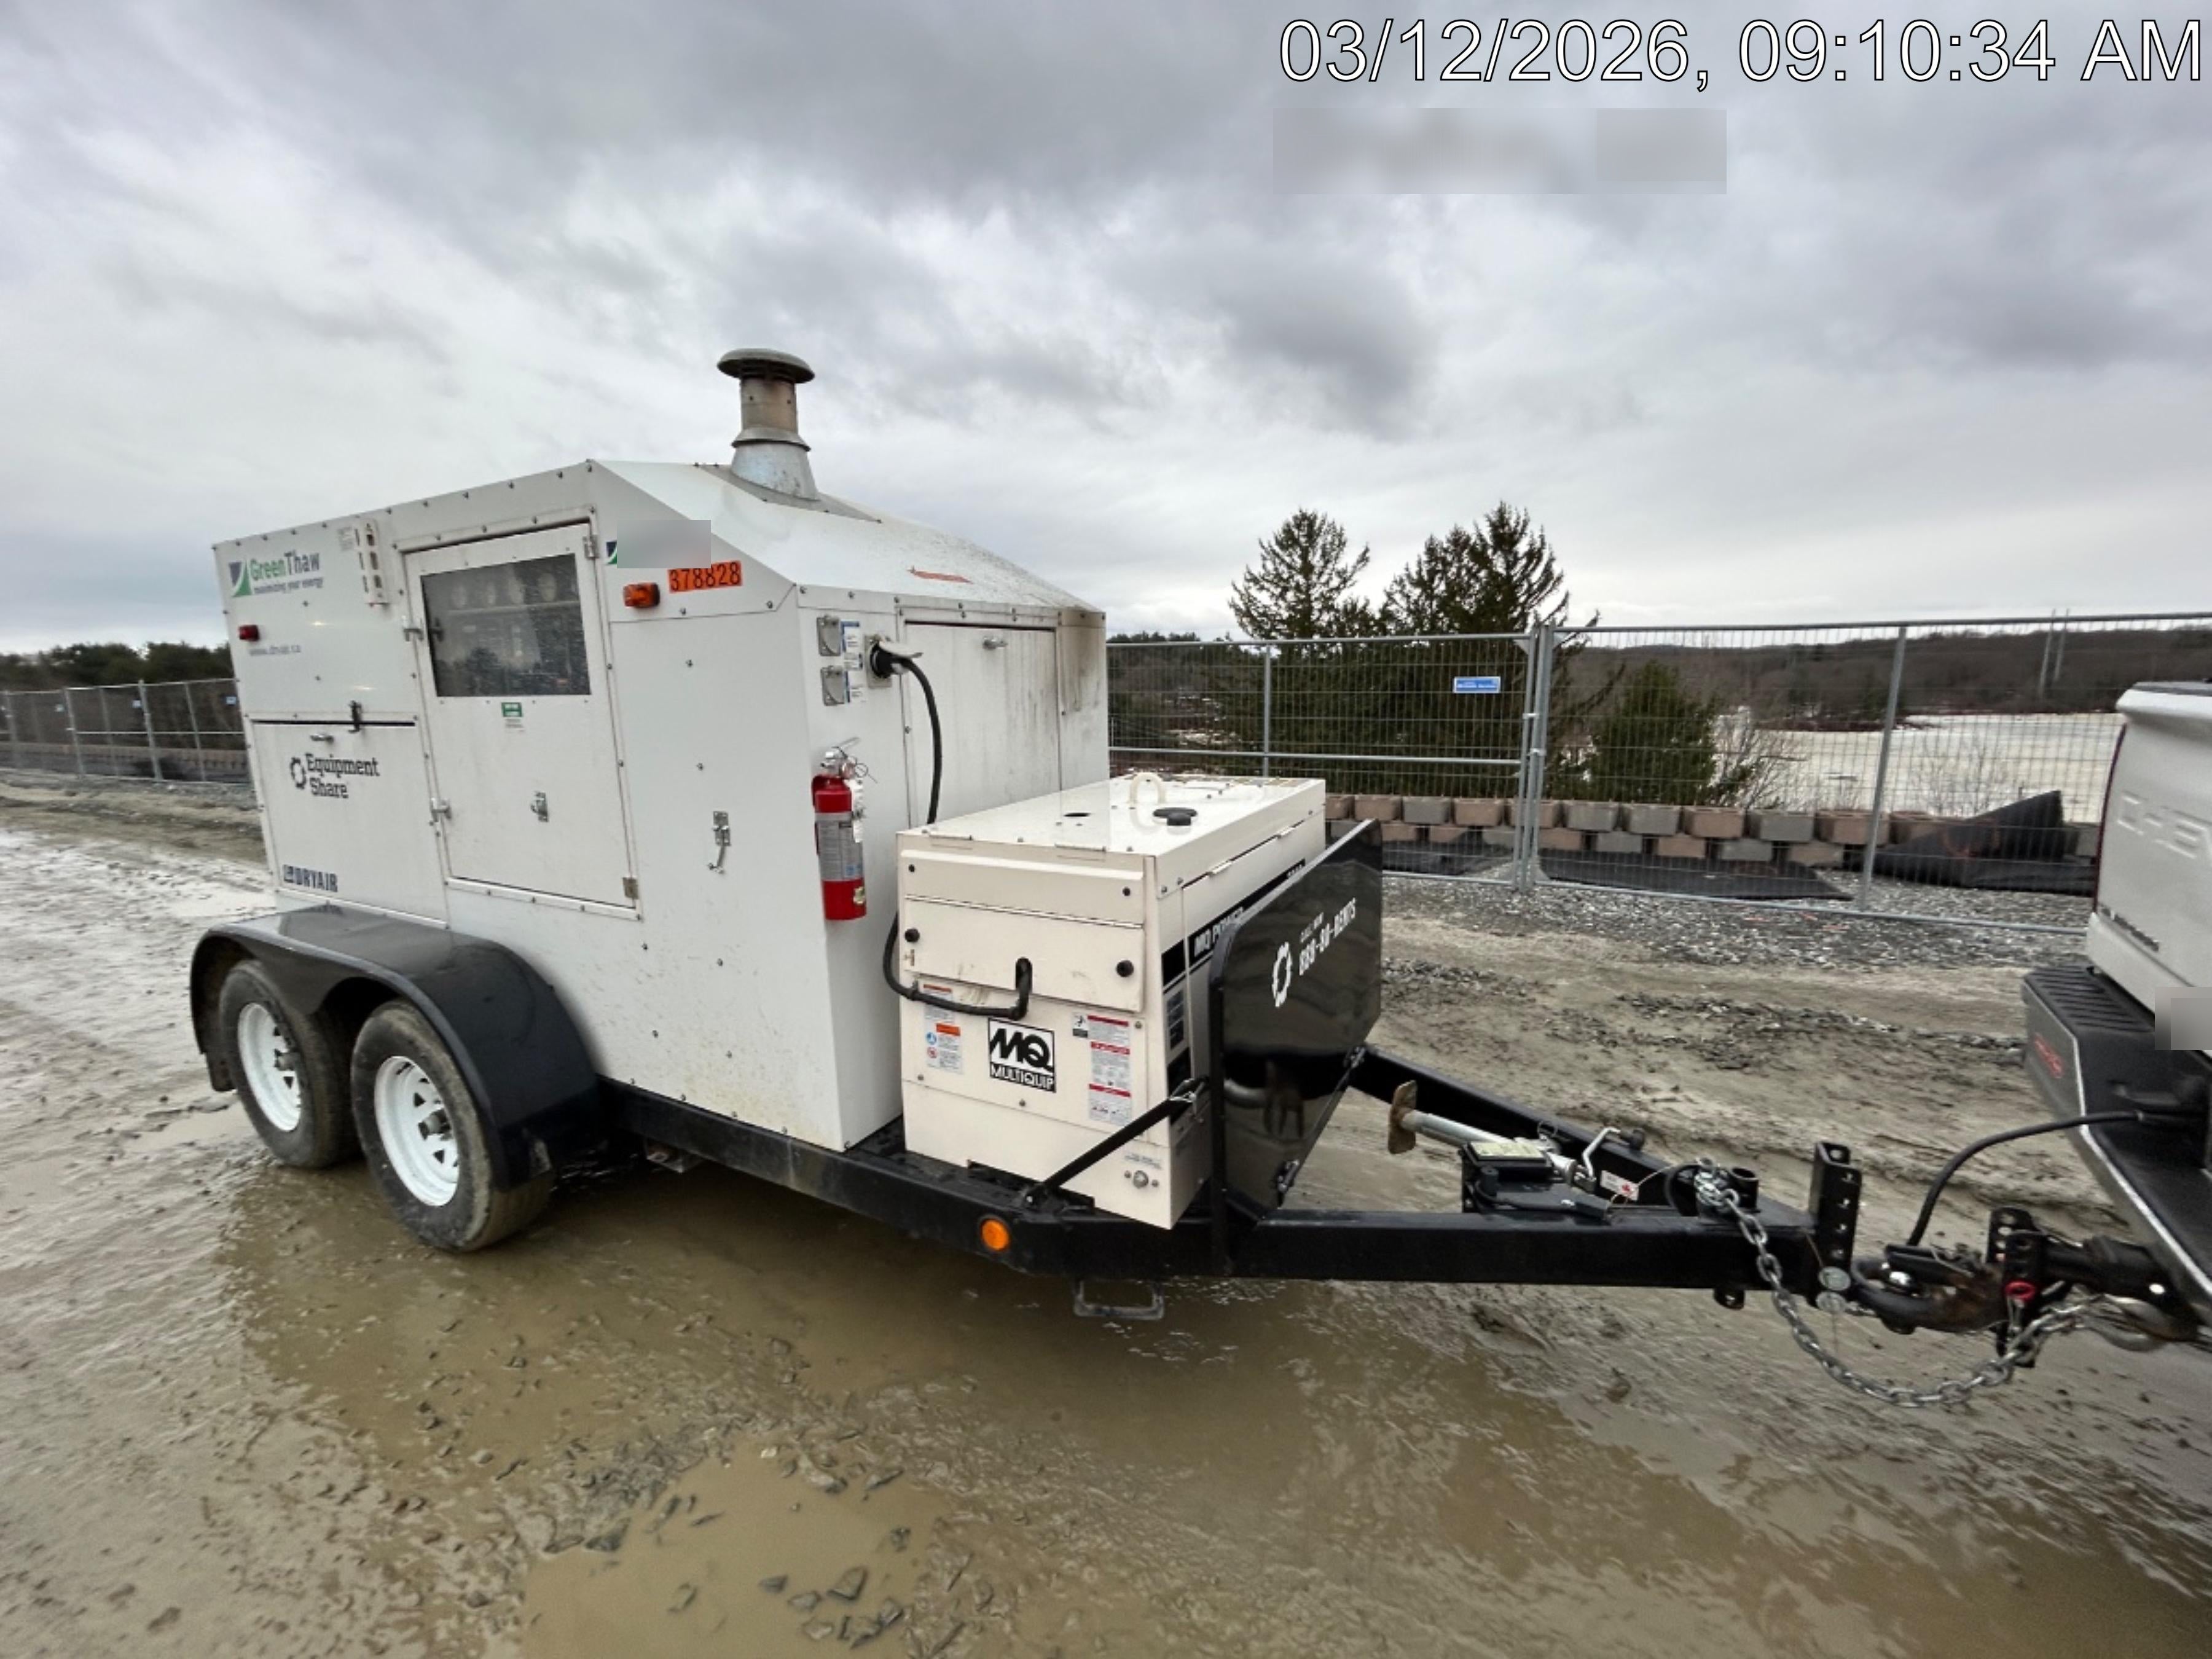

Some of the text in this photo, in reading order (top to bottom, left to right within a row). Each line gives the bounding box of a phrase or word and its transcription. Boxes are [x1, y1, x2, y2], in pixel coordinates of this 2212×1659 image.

[670, 561, 740, 592] 378828
[305, 752, 380, 779] Equipment
[310, 777, 349, 799] Share
[989, 1027, 1054, 1073] MQ
[991, 1064, 1054, 1090] MULTIQUIP
